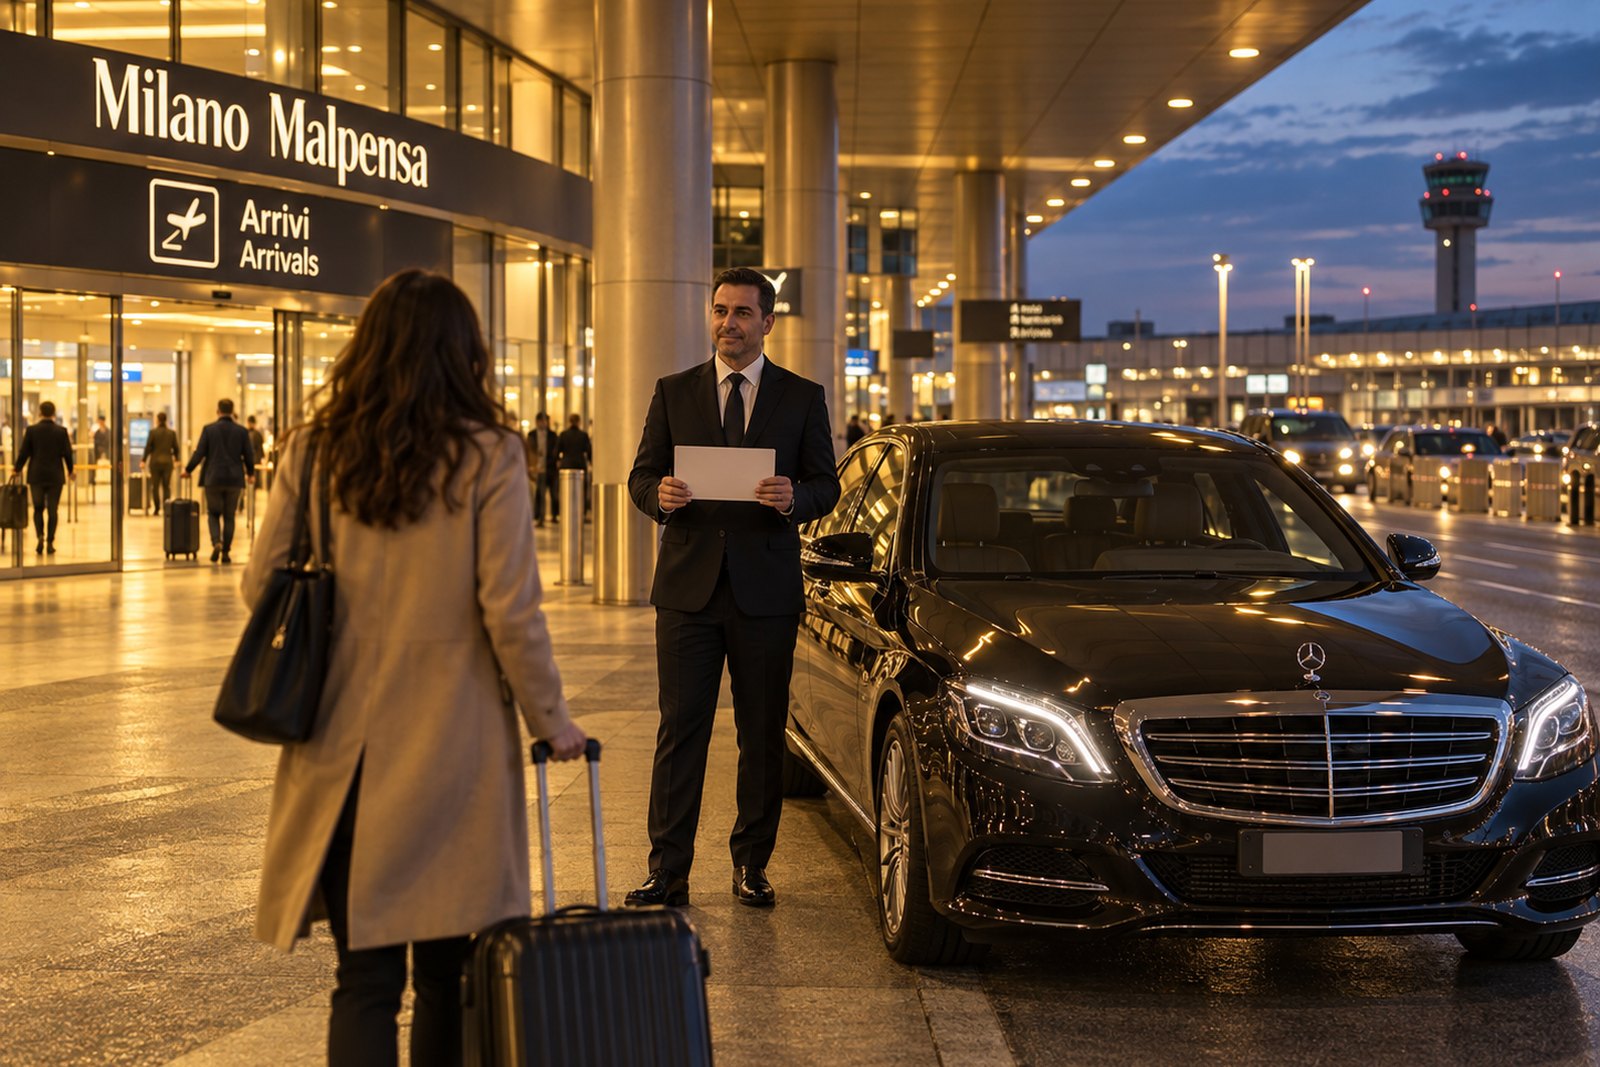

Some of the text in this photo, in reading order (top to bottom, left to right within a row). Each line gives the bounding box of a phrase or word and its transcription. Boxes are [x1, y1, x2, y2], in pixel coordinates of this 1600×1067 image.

[93, 57, 428, 188] Milano Malpensa
[239, 199, 310, 241] Arrivi
[239, 239, 320, 278] Arrivals
